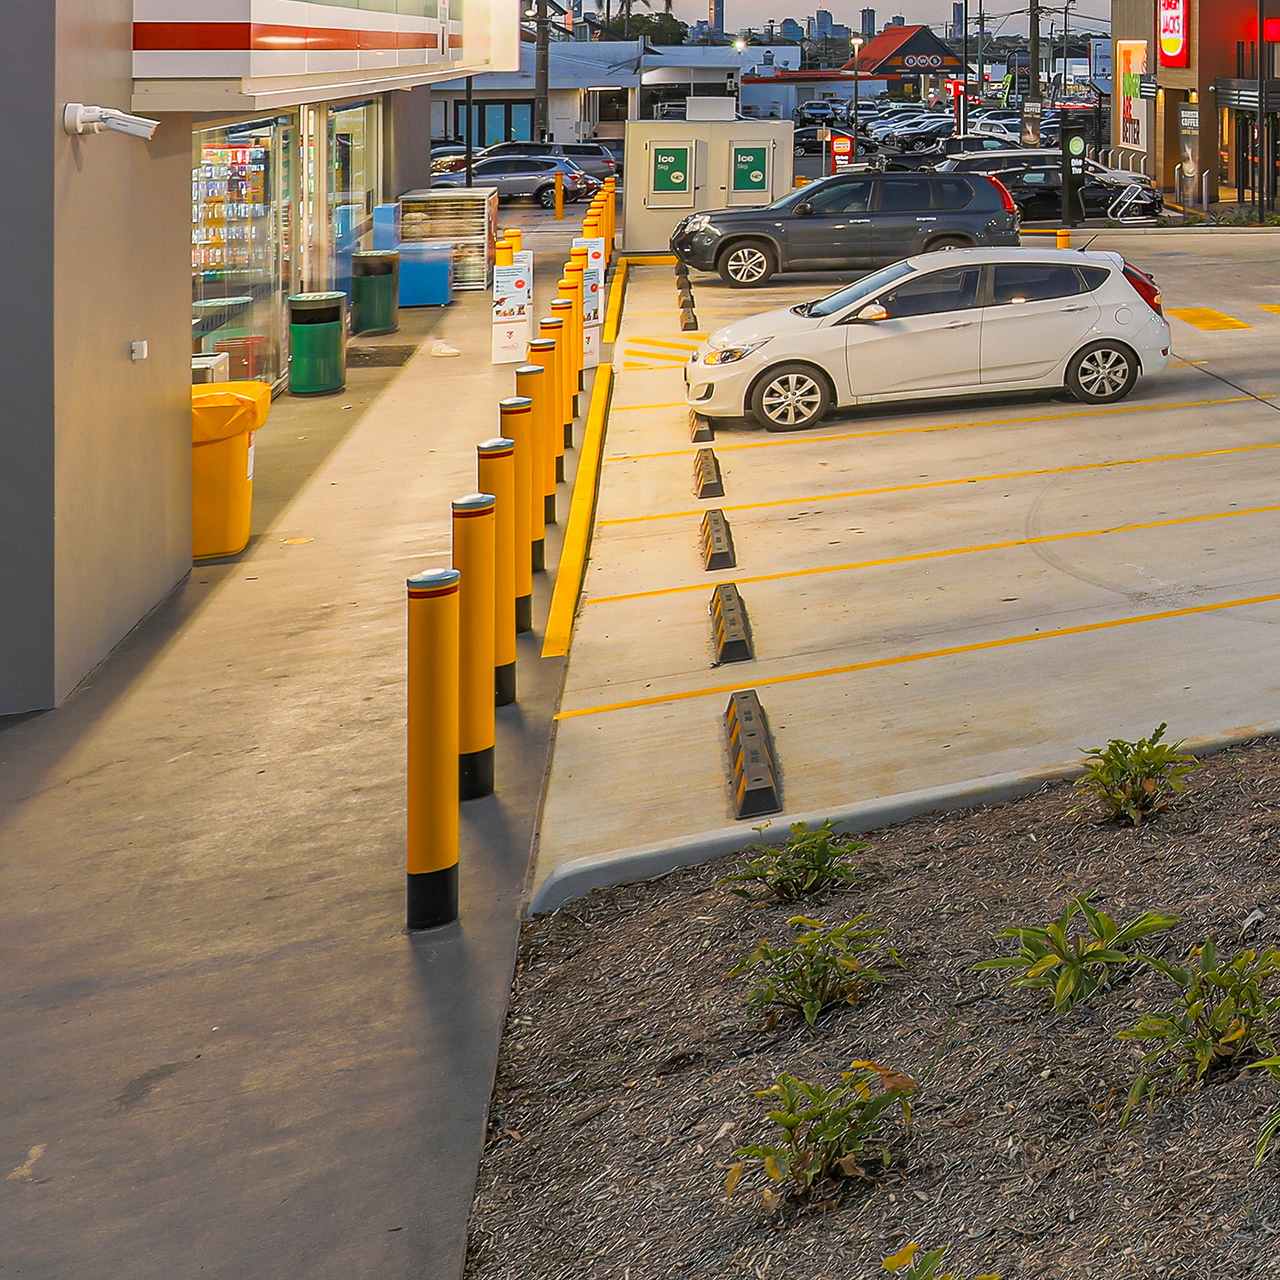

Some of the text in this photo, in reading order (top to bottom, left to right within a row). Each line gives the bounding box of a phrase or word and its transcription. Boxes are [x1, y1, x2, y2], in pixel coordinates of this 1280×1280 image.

[1181, 118, 1200, 127] COFFEE
[658, 154, 675, 163] Ice
[737, 154, 754, 163] Ice
